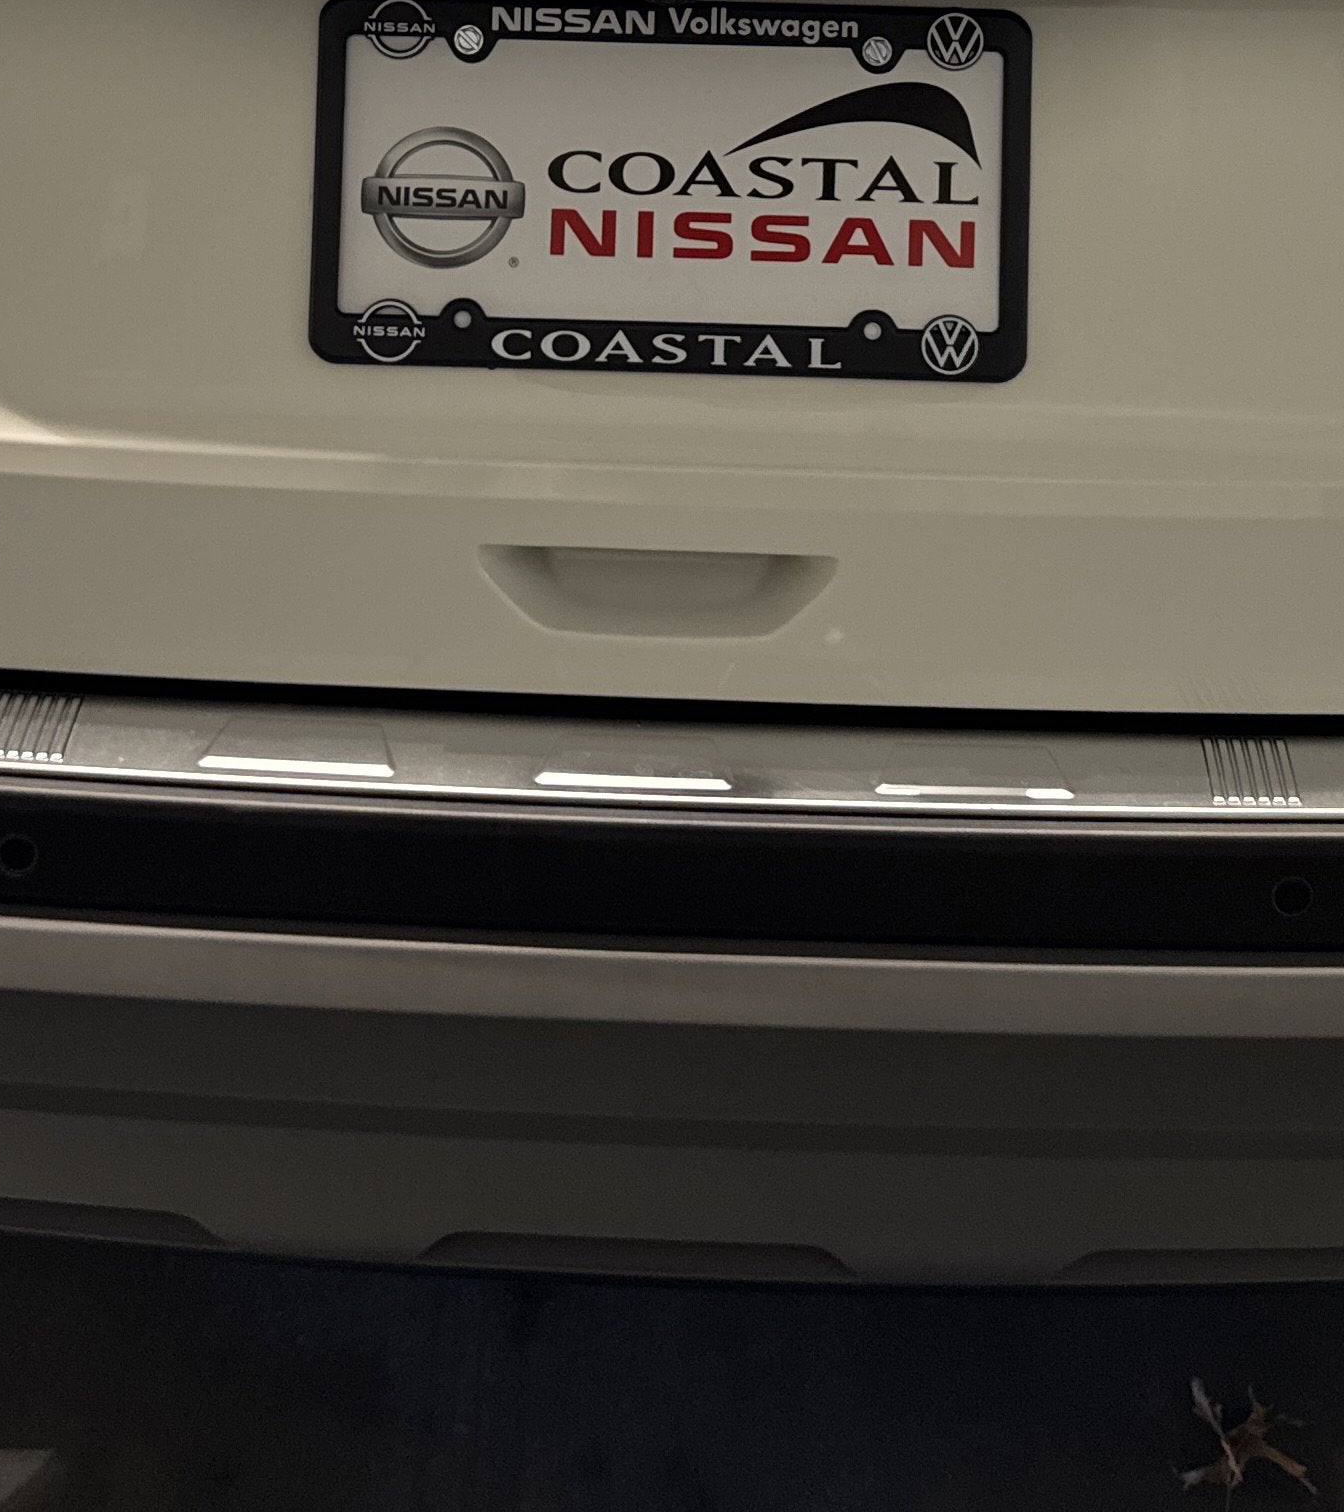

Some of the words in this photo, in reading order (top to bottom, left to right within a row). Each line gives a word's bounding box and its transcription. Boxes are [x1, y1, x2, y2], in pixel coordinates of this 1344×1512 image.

[363, 20, 436, 35] NISSAN
[491, 5, 657, 36] NISSAN
[668, 6, 859, 42] Volkswagen
[547, 149, 981, 207] COASTAL
[377, 184, 509, 211] NISSAN
[548, 207, 976, 269] NISSAN
[353, 324, 426, 338] NISSAN
[490, 328, 843, 370] COASTAL
